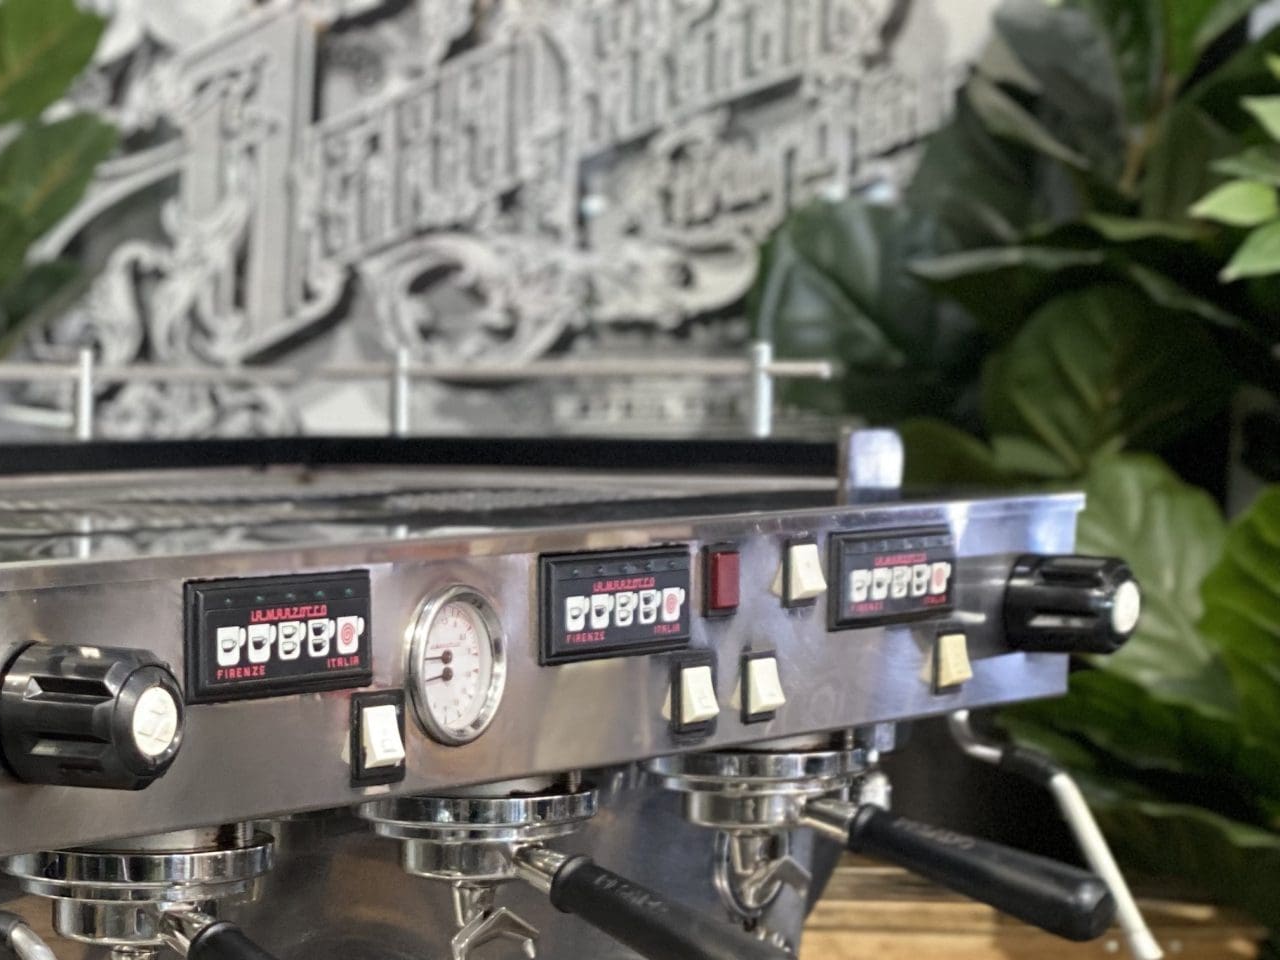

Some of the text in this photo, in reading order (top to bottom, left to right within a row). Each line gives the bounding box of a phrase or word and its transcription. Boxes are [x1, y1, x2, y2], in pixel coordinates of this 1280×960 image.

[566, 632, 606, 644] FIRENZE
[326, 655, 360, 669] ITALIA
[216, 664, 266, 681] FIRENZE
